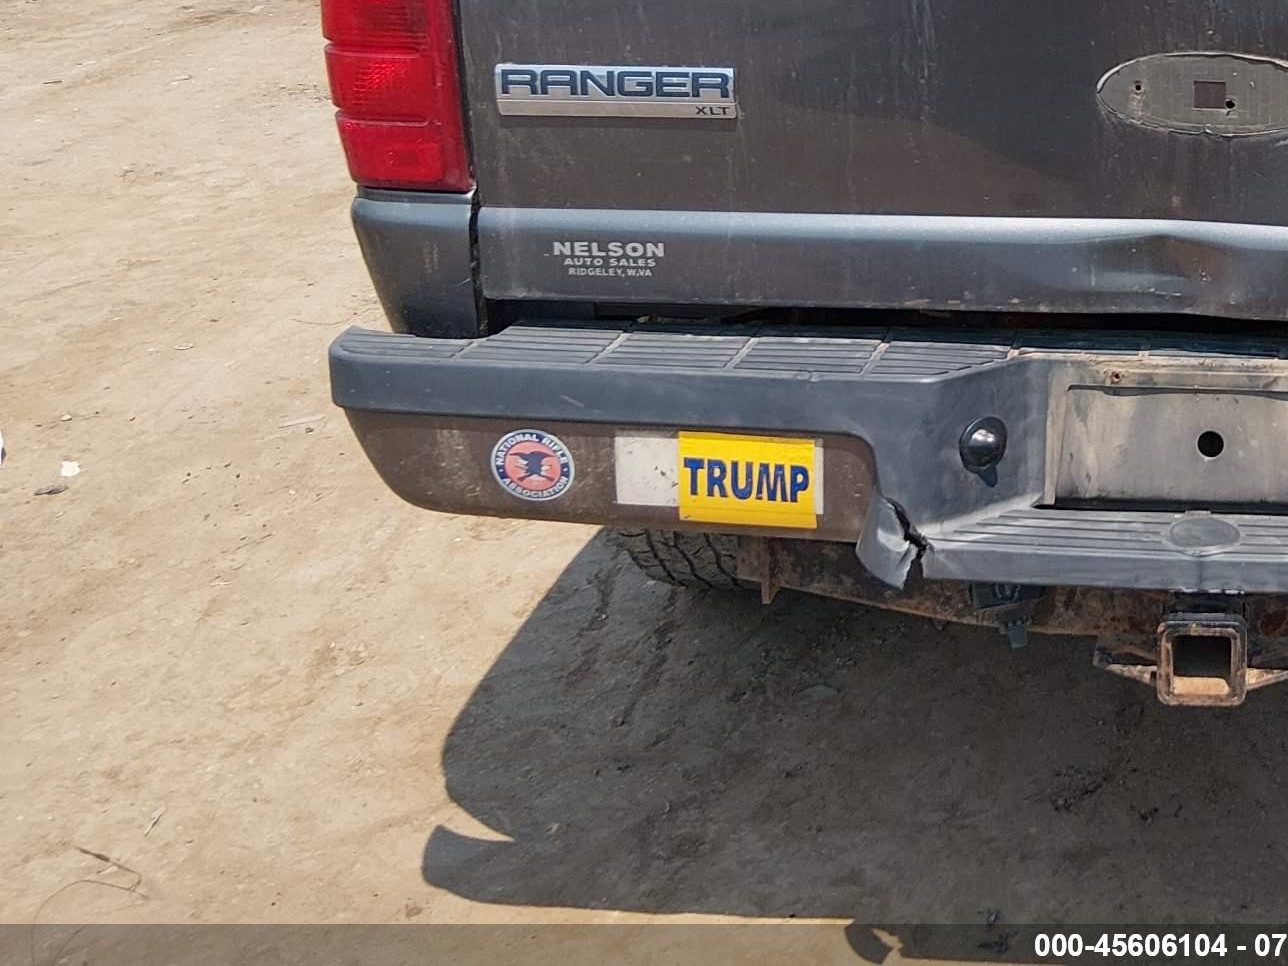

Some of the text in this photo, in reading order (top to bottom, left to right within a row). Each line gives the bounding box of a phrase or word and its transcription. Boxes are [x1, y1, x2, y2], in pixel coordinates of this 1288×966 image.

[500, 69, 730, 98] RANGER
[695, 106, 730, 116] XLT
[553, 241, 665, 257] NELSON
[563, 257, 656, 267] AUTO SALES
[495, 433, 569, 466] NATIONAL RIFLE
[502, 476, 569, 498] ASSOCIATION
[683, 457, 810, 503] TRUMP
